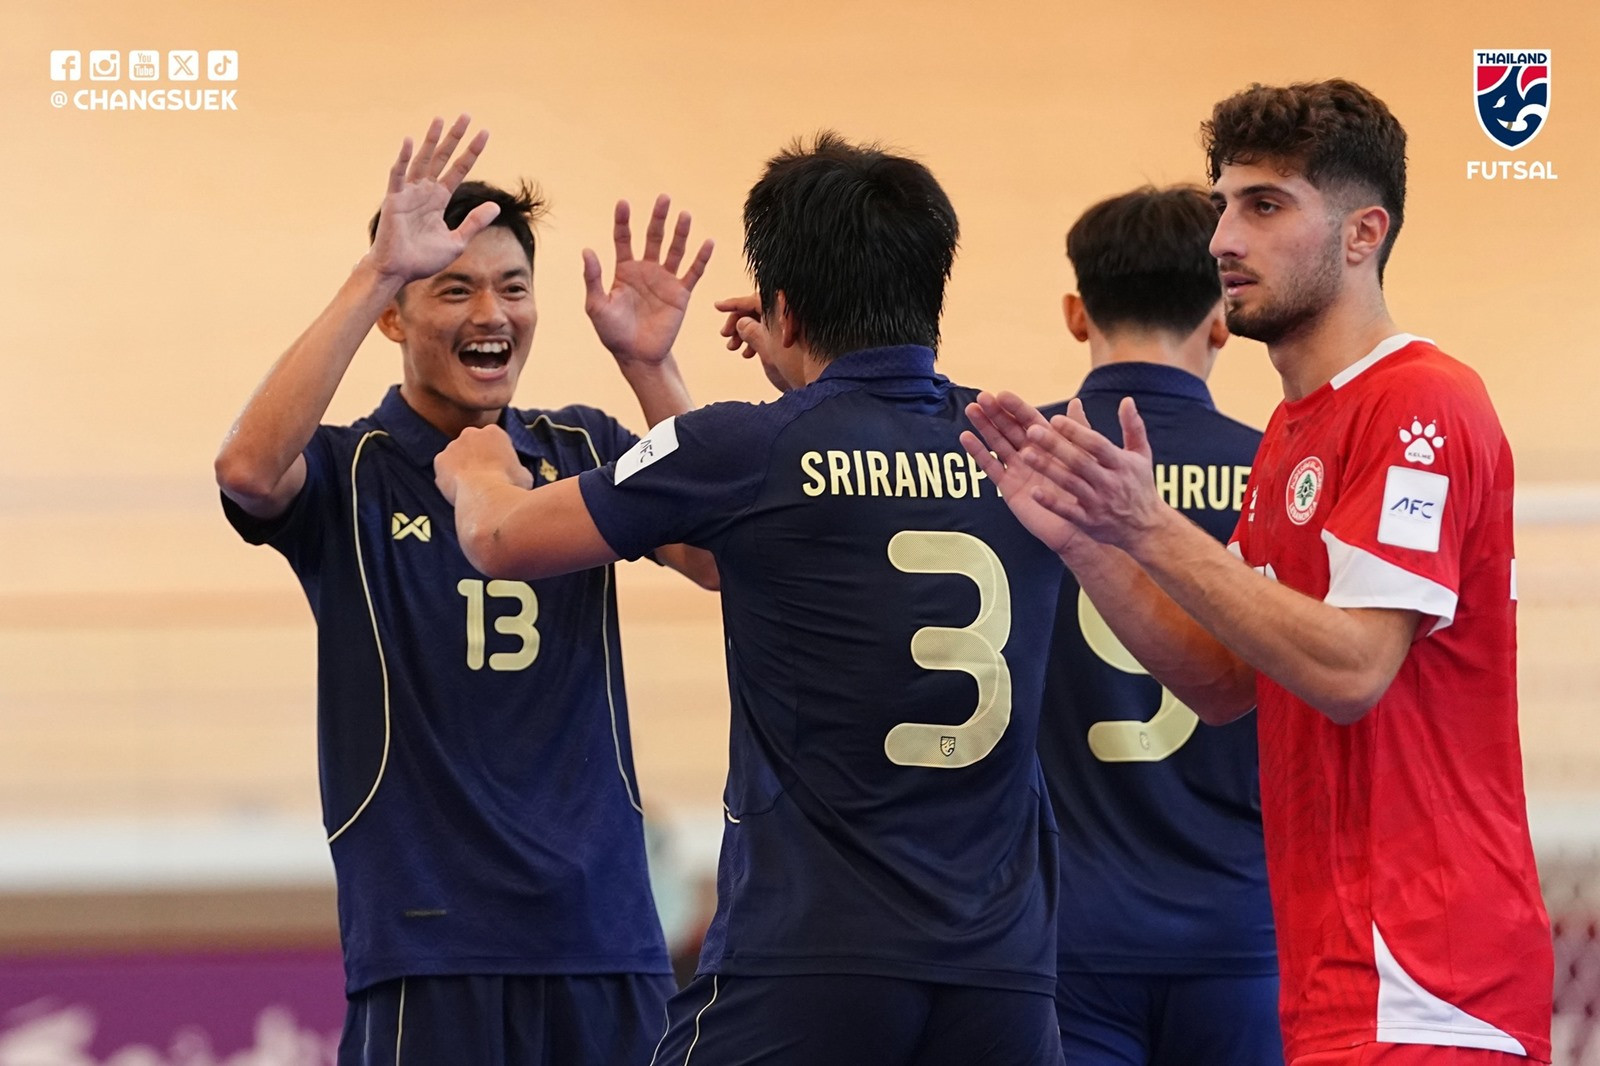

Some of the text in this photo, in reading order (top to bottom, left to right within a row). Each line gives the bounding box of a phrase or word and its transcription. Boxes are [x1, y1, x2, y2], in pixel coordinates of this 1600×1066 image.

[800, 450, 1008, 499] SRIRANGP
[1155, 463, 1252, 511] HRUE
[1390, 496, 1435, 519] AFC
[457, 578, 541, 672] 13
[884, 530, 1012, 769] 3
